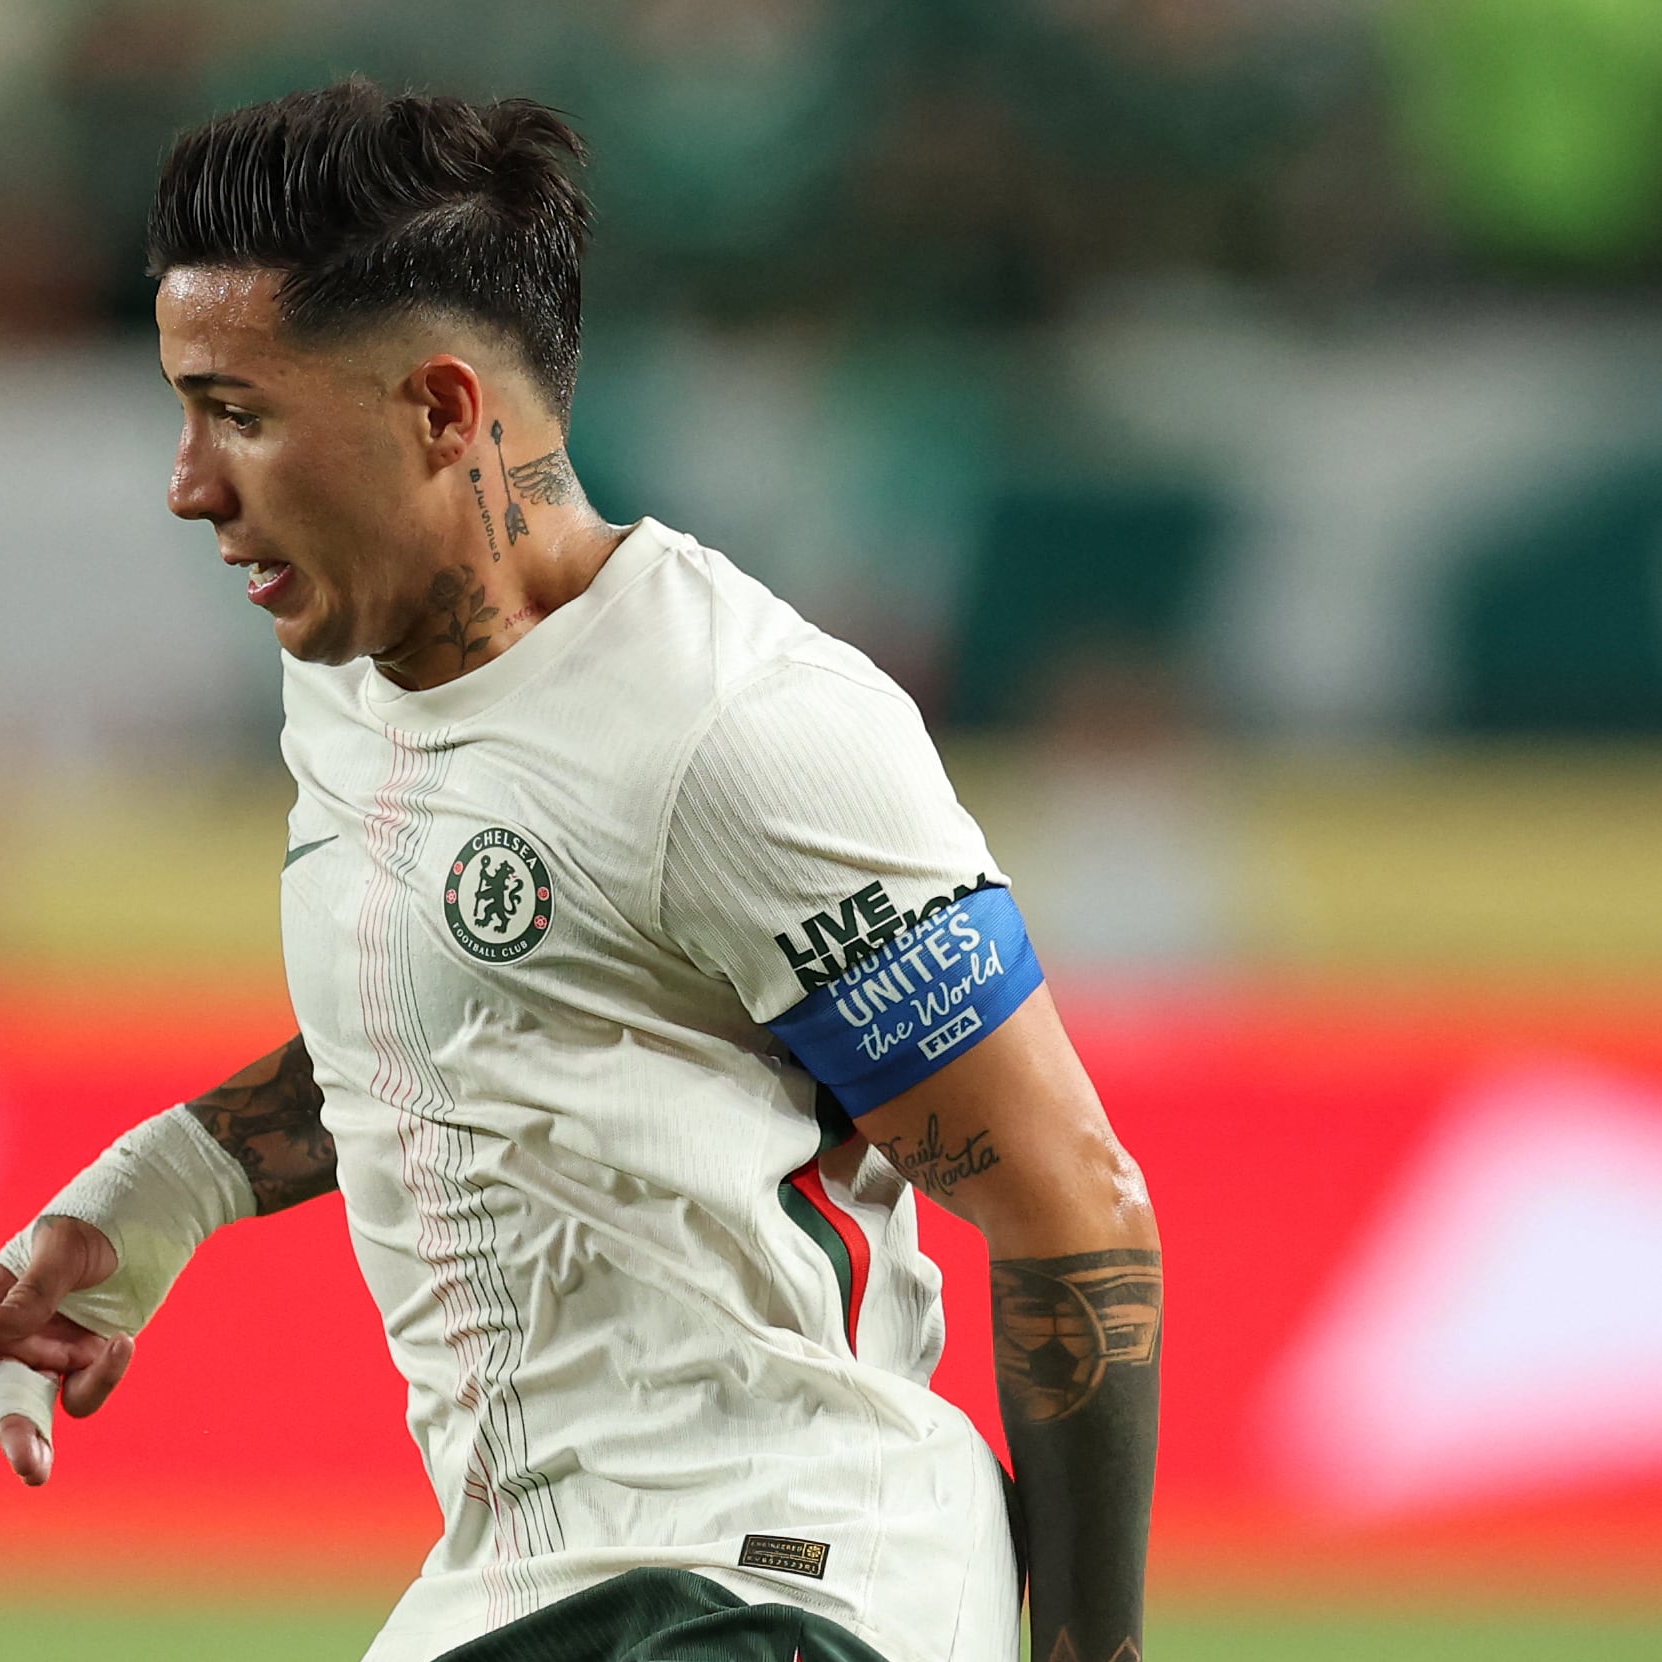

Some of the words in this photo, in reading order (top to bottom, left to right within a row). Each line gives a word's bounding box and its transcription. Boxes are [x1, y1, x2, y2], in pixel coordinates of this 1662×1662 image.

[472, 830, 538, 870] CHELSEA
[453, 922, 496, 957] FOOTBALL
[502, 940, 528, 957] CLUB
[774, 880, 899, 969] LIVE
[835, 912, 981, 1028] UNITES
[856, 1020, 913, 1061] the
[909, 940, 1004, 1027] World
[926, 1014, 979, 1055] FIFA
[922, 1130, 999, 1196] Marta
